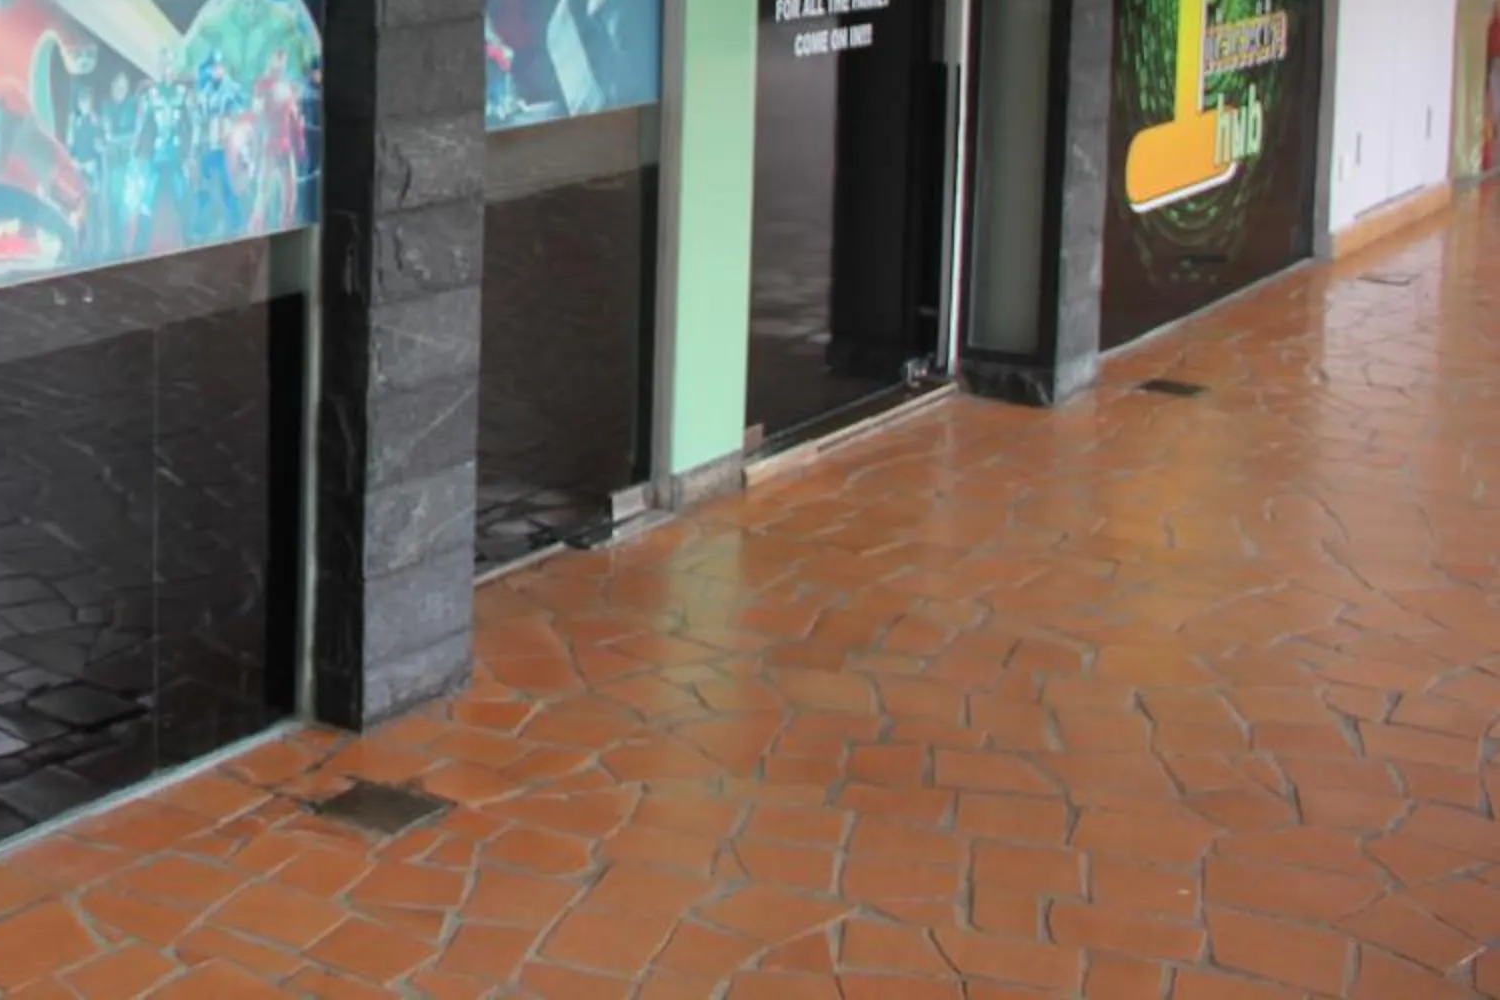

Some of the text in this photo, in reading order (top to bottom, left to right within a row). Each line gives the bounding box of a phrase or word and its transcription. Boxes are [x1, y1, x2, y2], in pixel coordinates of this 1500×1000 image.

[794, 30, 829, 57] COME
[831, 27, 849, 50] ON
[1214, 82, 1263, 166] hub
